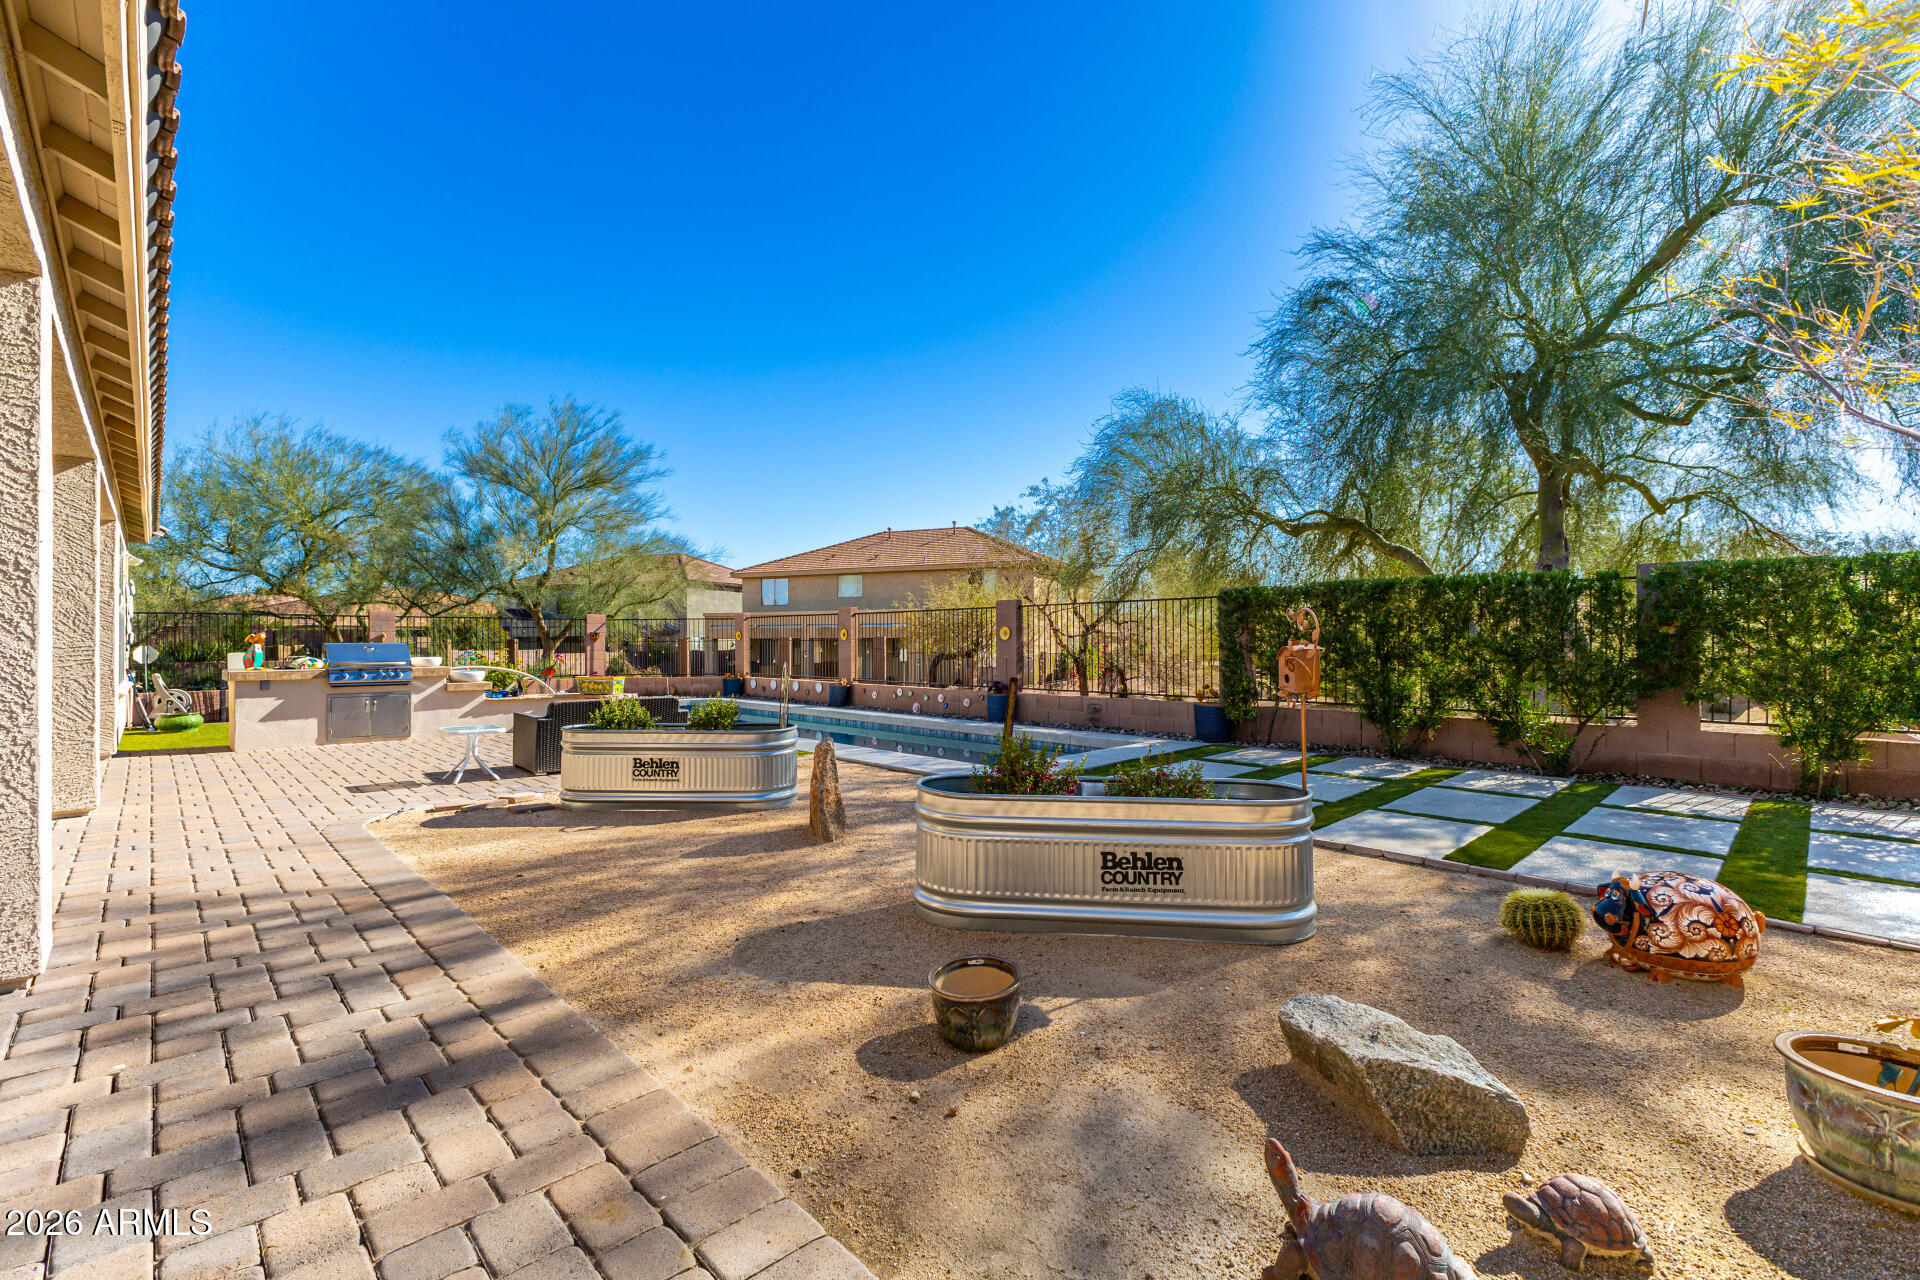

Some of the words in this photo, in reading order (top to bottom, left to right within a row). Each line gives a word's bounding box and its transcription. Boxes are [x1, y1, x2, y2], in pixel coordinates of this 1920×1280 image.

[633, 758, 679, 768] Behlen
[632, 769, 679, 777] COUNTRY
[1100, 851, 1184, 871] Behlen
[1101, 871, 1183, 885] COUNTRY
